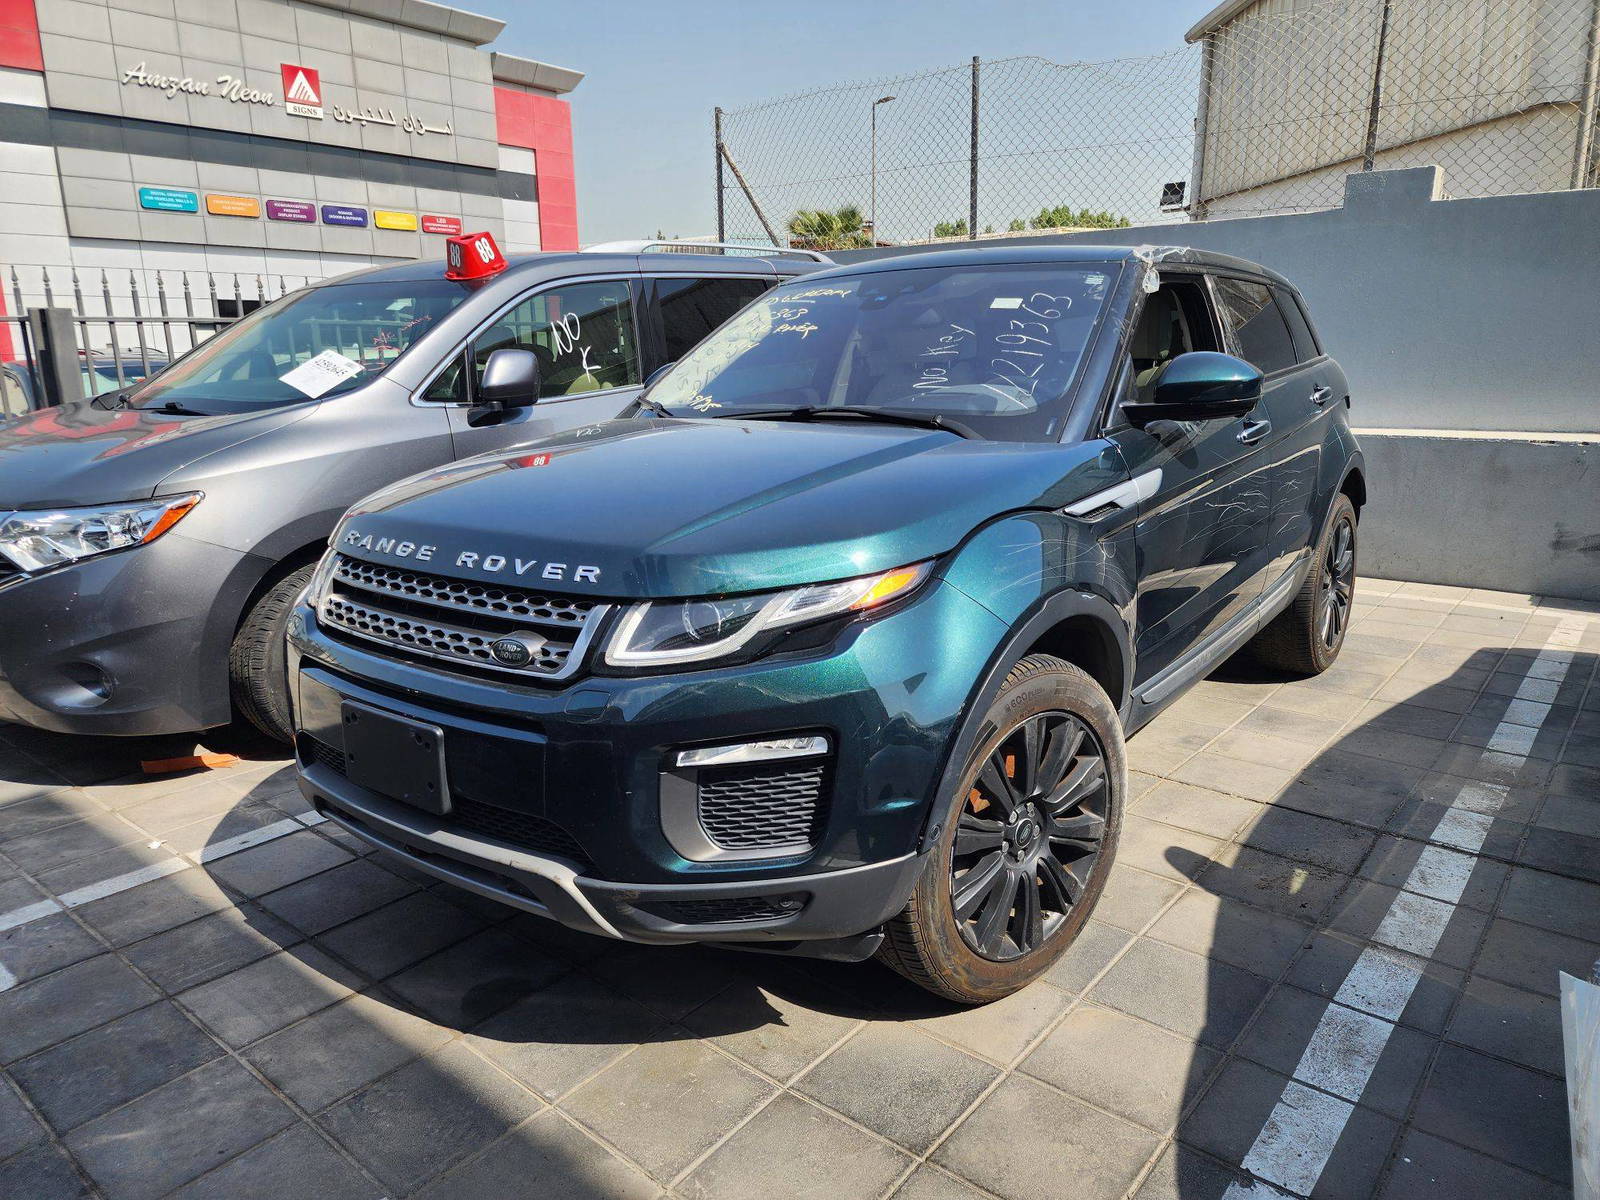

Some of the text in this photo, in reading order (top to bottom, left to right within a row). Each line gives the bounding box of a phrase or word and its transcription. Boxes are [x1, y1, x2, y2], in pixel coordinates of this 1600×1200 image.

[122, 62, 274, 106] Amzan Neon
[292, 106, 318, 116] SIGNS
[450, 243, 461, 267] 88
[475, 237, 495, 264] 88
[344, 529, 602, 583] RANGE ROVER
[499, 643, 517, 652] LAND
[500, 651, 521, 660] ROVER
